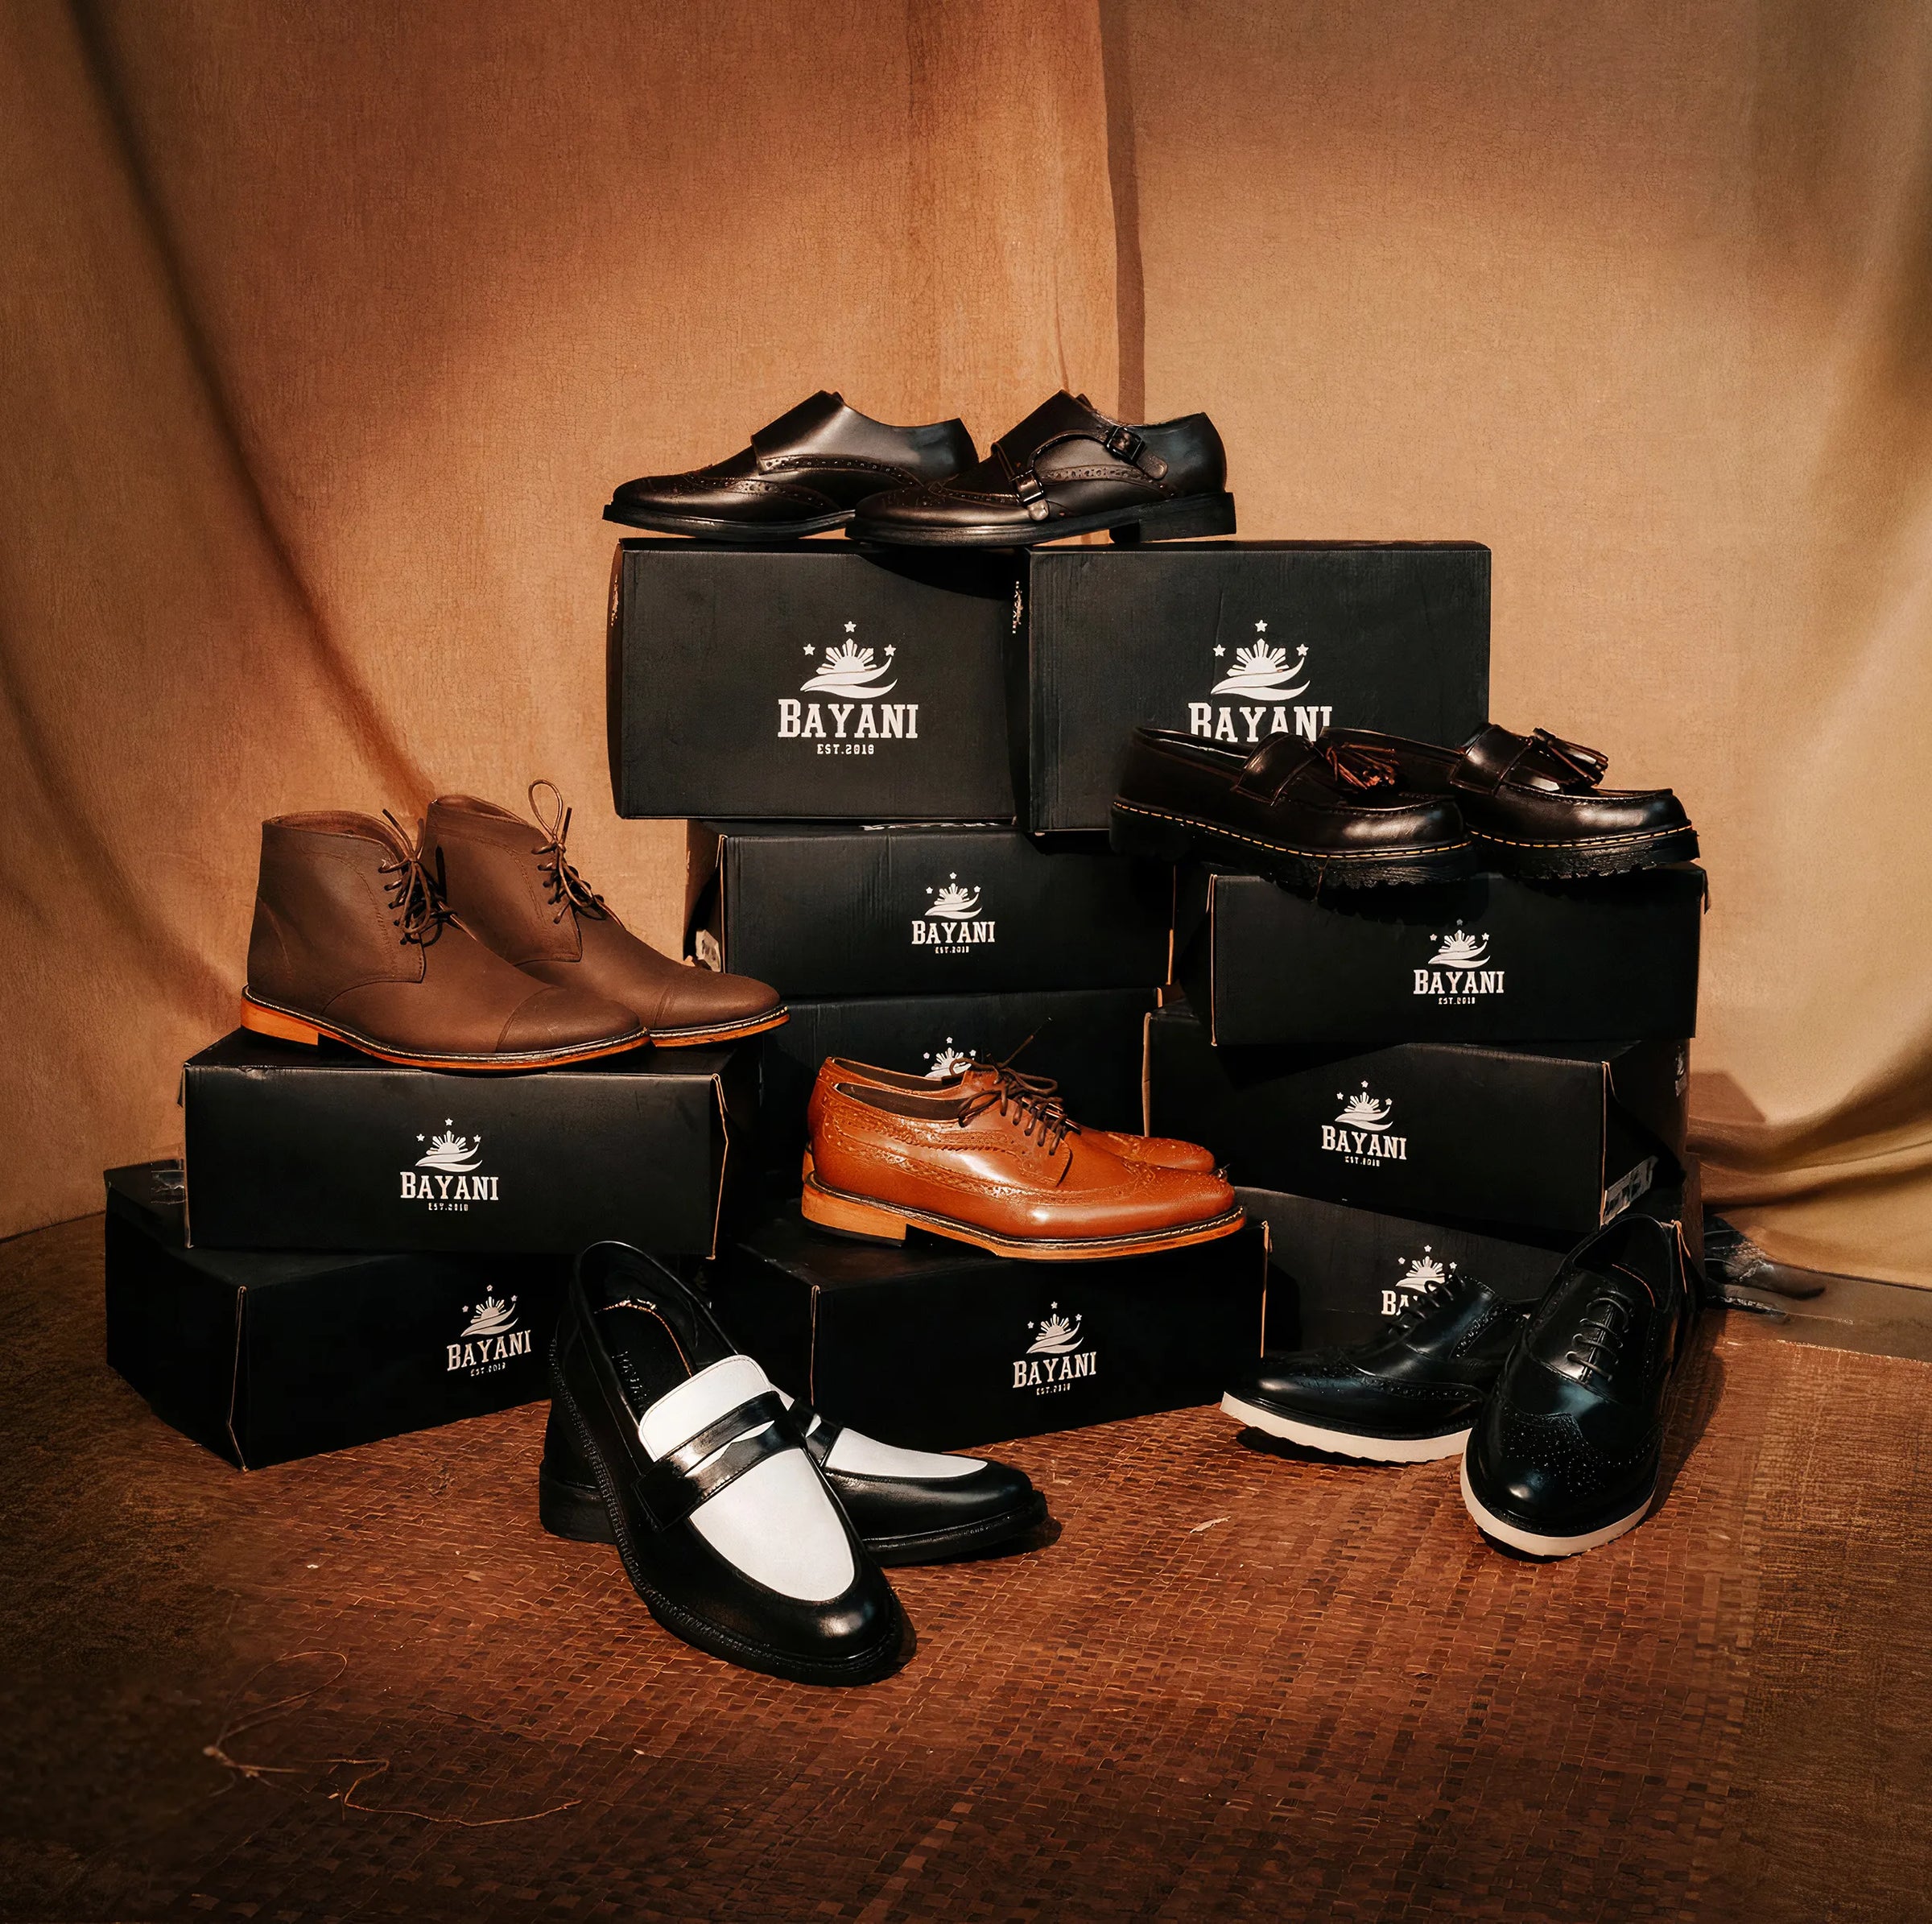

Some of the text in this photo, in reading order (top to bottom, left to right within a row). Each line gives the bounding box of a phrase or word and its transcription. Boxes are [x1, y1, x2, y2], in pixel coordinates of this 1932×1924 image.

[777, 699, 919, 739] BAYANI
[911, 920, 996, 945] BAYANI
[1413, 969, 1505, 995] BAYANI
[1321, 1125, 1407, 1160] BAYANI
[400, 1171, 499, 1201] BAYANI
[446, 1329, 531, 1372] BAYANI
[1012, 1352, 1097, 1389] BAYANI
